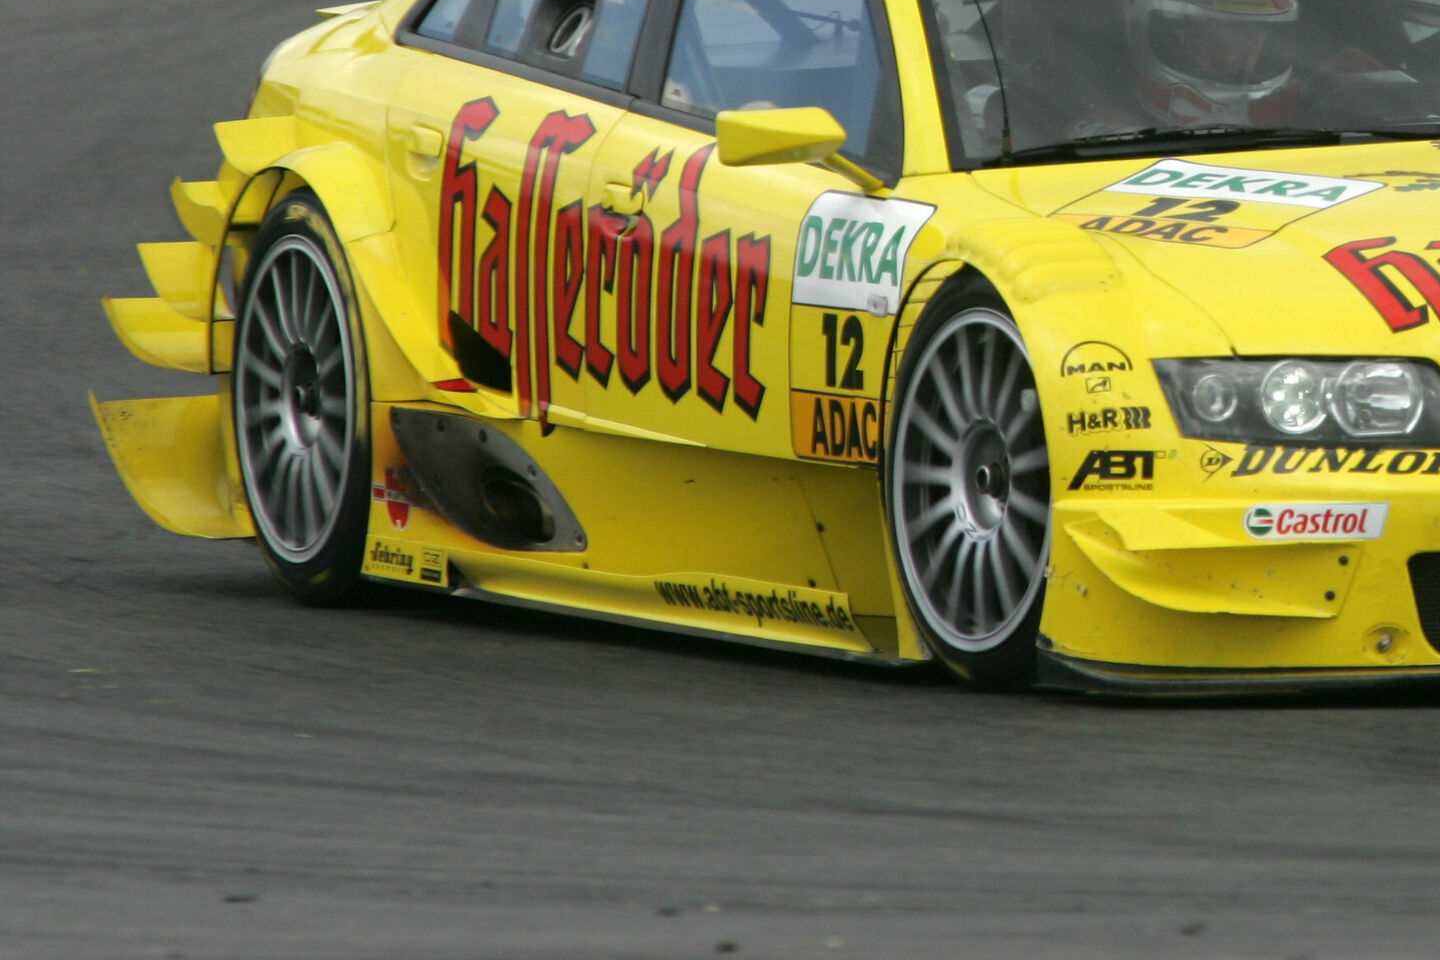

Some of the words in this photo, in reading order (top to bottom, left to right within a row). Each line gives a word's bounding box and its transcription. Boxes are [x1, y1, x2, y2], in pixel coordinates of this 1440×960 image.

[1122, 167, 1351, 202] DEKRA
[1131, 197, 1241, 222] 12
[1079, 216, 1230, 242] ADAC
[796, 214, 907, 287] DEKRA
[821, 312, 865, 390] 12
[1066, 361, 1126, 376] MAN
[811, 397, 877, 459] ADAC
[1067, 407, 1118, 434] H&R
[1066, 450, 1154, 491] ABT
[1083, 483, 1154, 491] SPORTSLINE
[1276, 508, 1368, 534] Castrol
[654, 578, 855, 632] www.abt-sportsline.de
